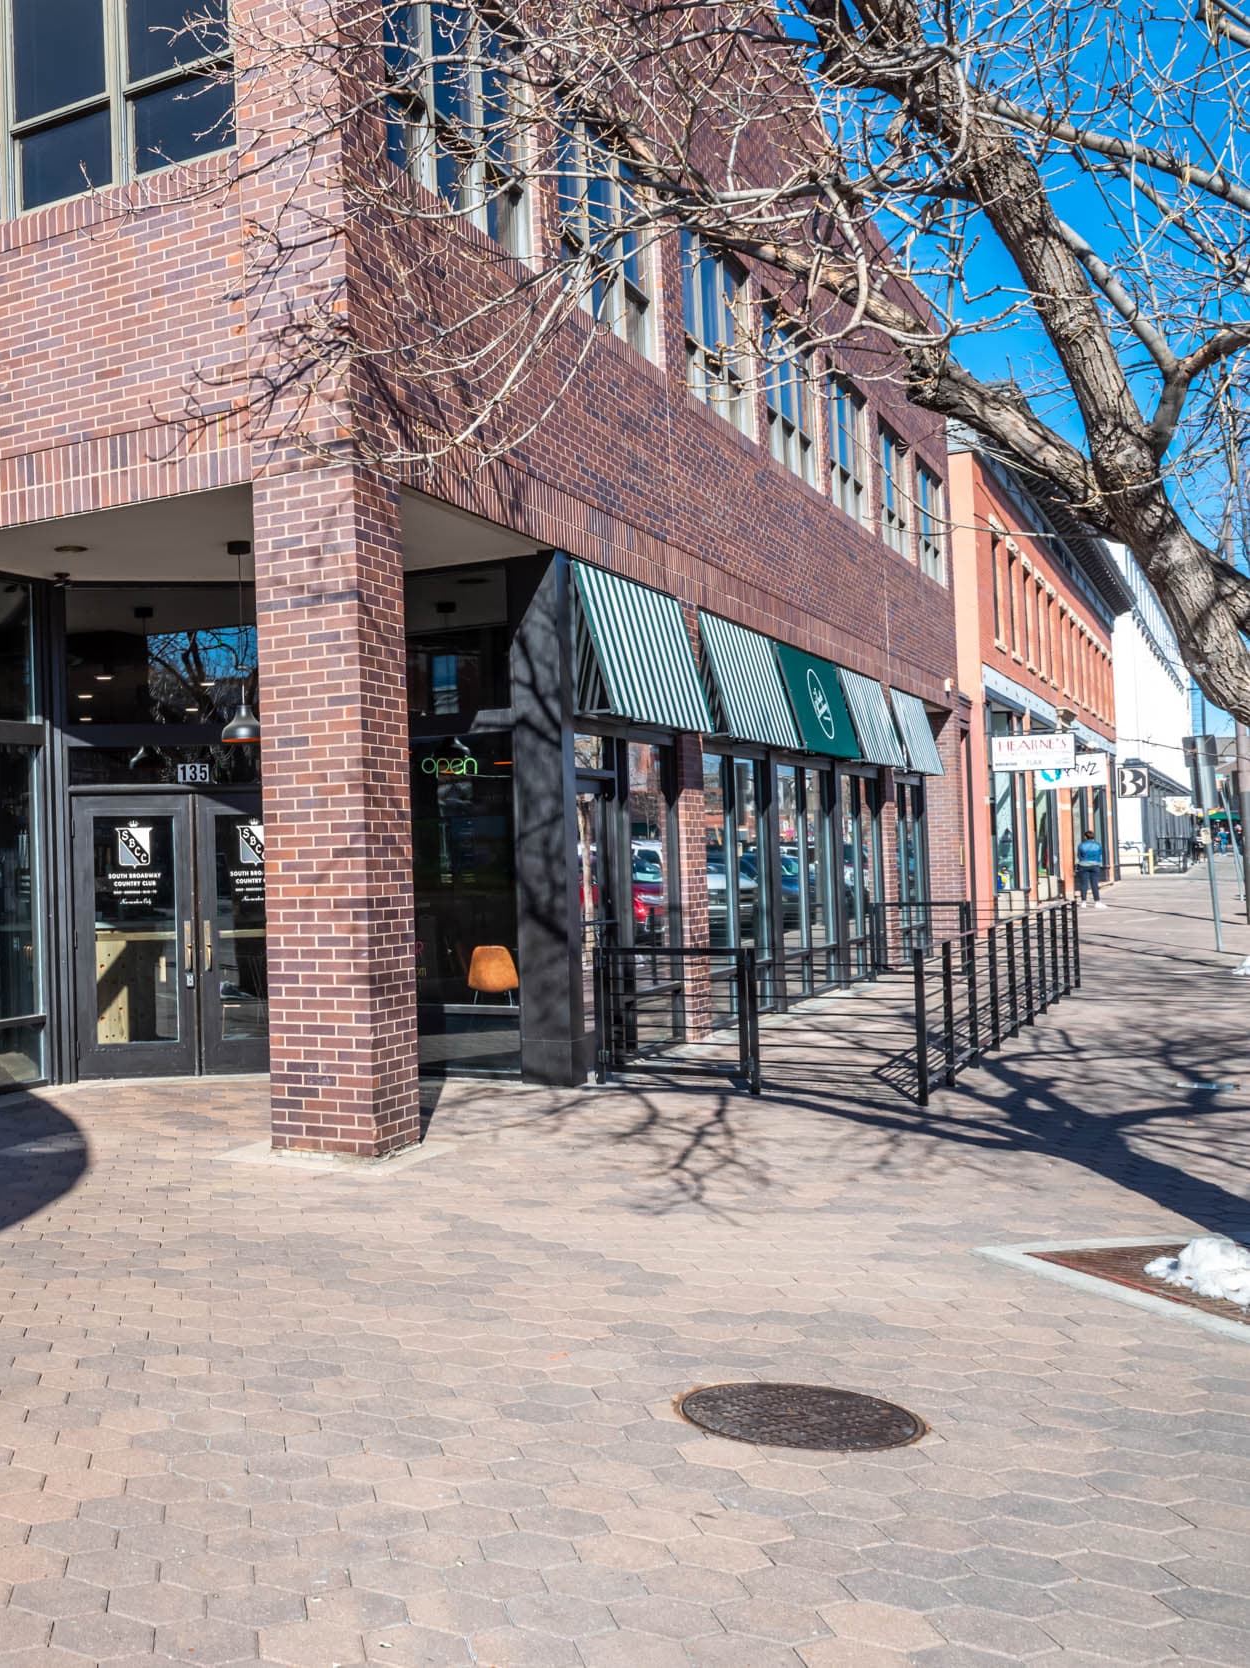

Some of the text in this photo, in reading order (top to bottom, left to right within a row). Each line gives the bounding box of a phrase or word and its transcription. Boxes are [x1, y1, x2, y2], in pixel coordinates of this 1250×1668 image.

[180, 764, 207, 781] 135
[421, 757, 478, 778] open
[121, 829, 149, 864] SBCC
[230, 870, 250, 878] SOUTH
[113, 880, 141, 888] COUNTRY
